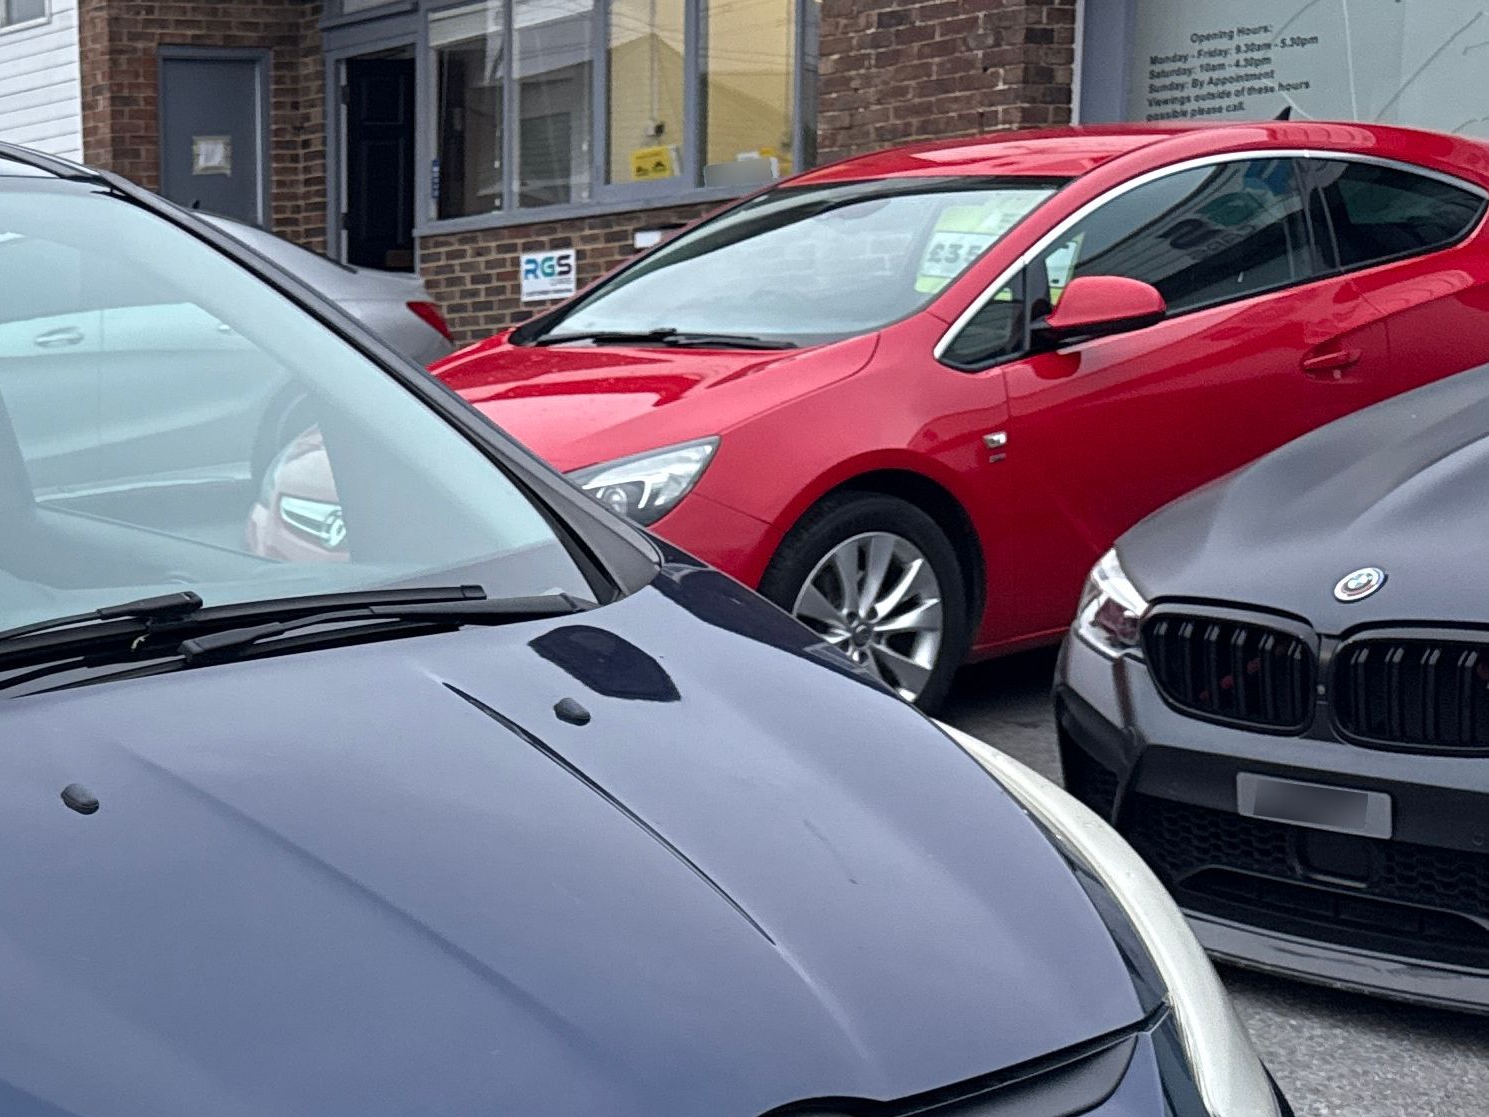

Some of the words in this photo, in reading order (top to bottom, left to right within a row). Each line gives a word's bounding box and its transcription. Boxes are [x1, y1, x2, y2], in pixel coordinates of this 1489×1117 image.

[1190, 30, 1234, 44] Opening
[1236, 24, 1272, 36] Hours:
[1150, 53, 1189, 66] Monday
[1197, 47, 1231, 60] Friday:
[1280, 36, 1319, 49] 5.30pm
[1148, 81, 1189, 95] Sunday:
[1191, 78, 1205, 90] By
[1207, 69, 1275, 86] Appointment
[1149, 67, 1195, 81] Saturday:
[1199, 62, 1226, 73] 10am
[1147, 95, 1191, 108] Viewings
[1194, 90, 1232, 102] outside
[1234, 86, 1246, 98] of
[1247, 85, 1275, 97] these
[1277, 80, 1310, 93] hours
[1146, 108, 1188, 122] possible
[1190, 104, 1223, 118] please
[524, 255, 572, 280] RGS
